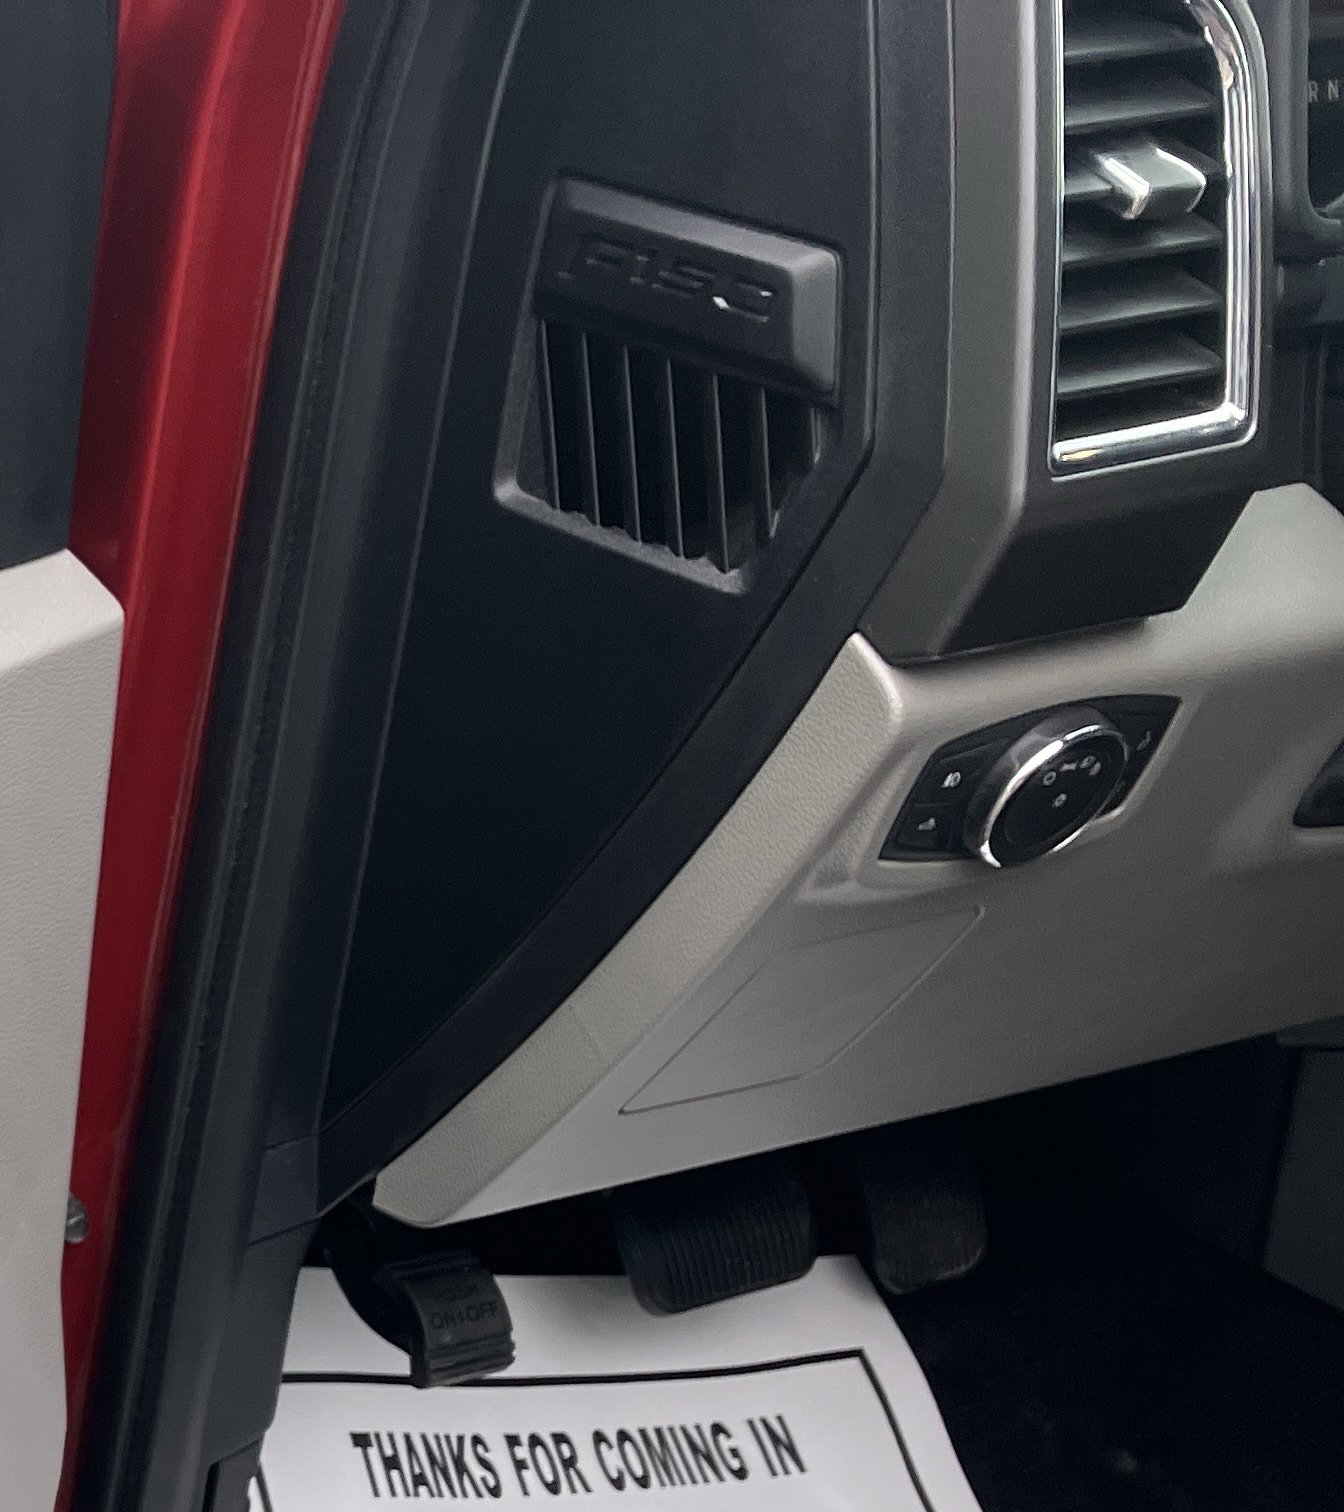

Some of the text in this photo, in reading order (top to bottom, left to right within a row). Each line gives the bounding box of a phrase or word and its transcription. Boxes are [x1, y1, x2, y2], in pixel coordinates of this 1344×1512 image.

[349, 1414, 808, 1499] THANKS FOR COMING IN
